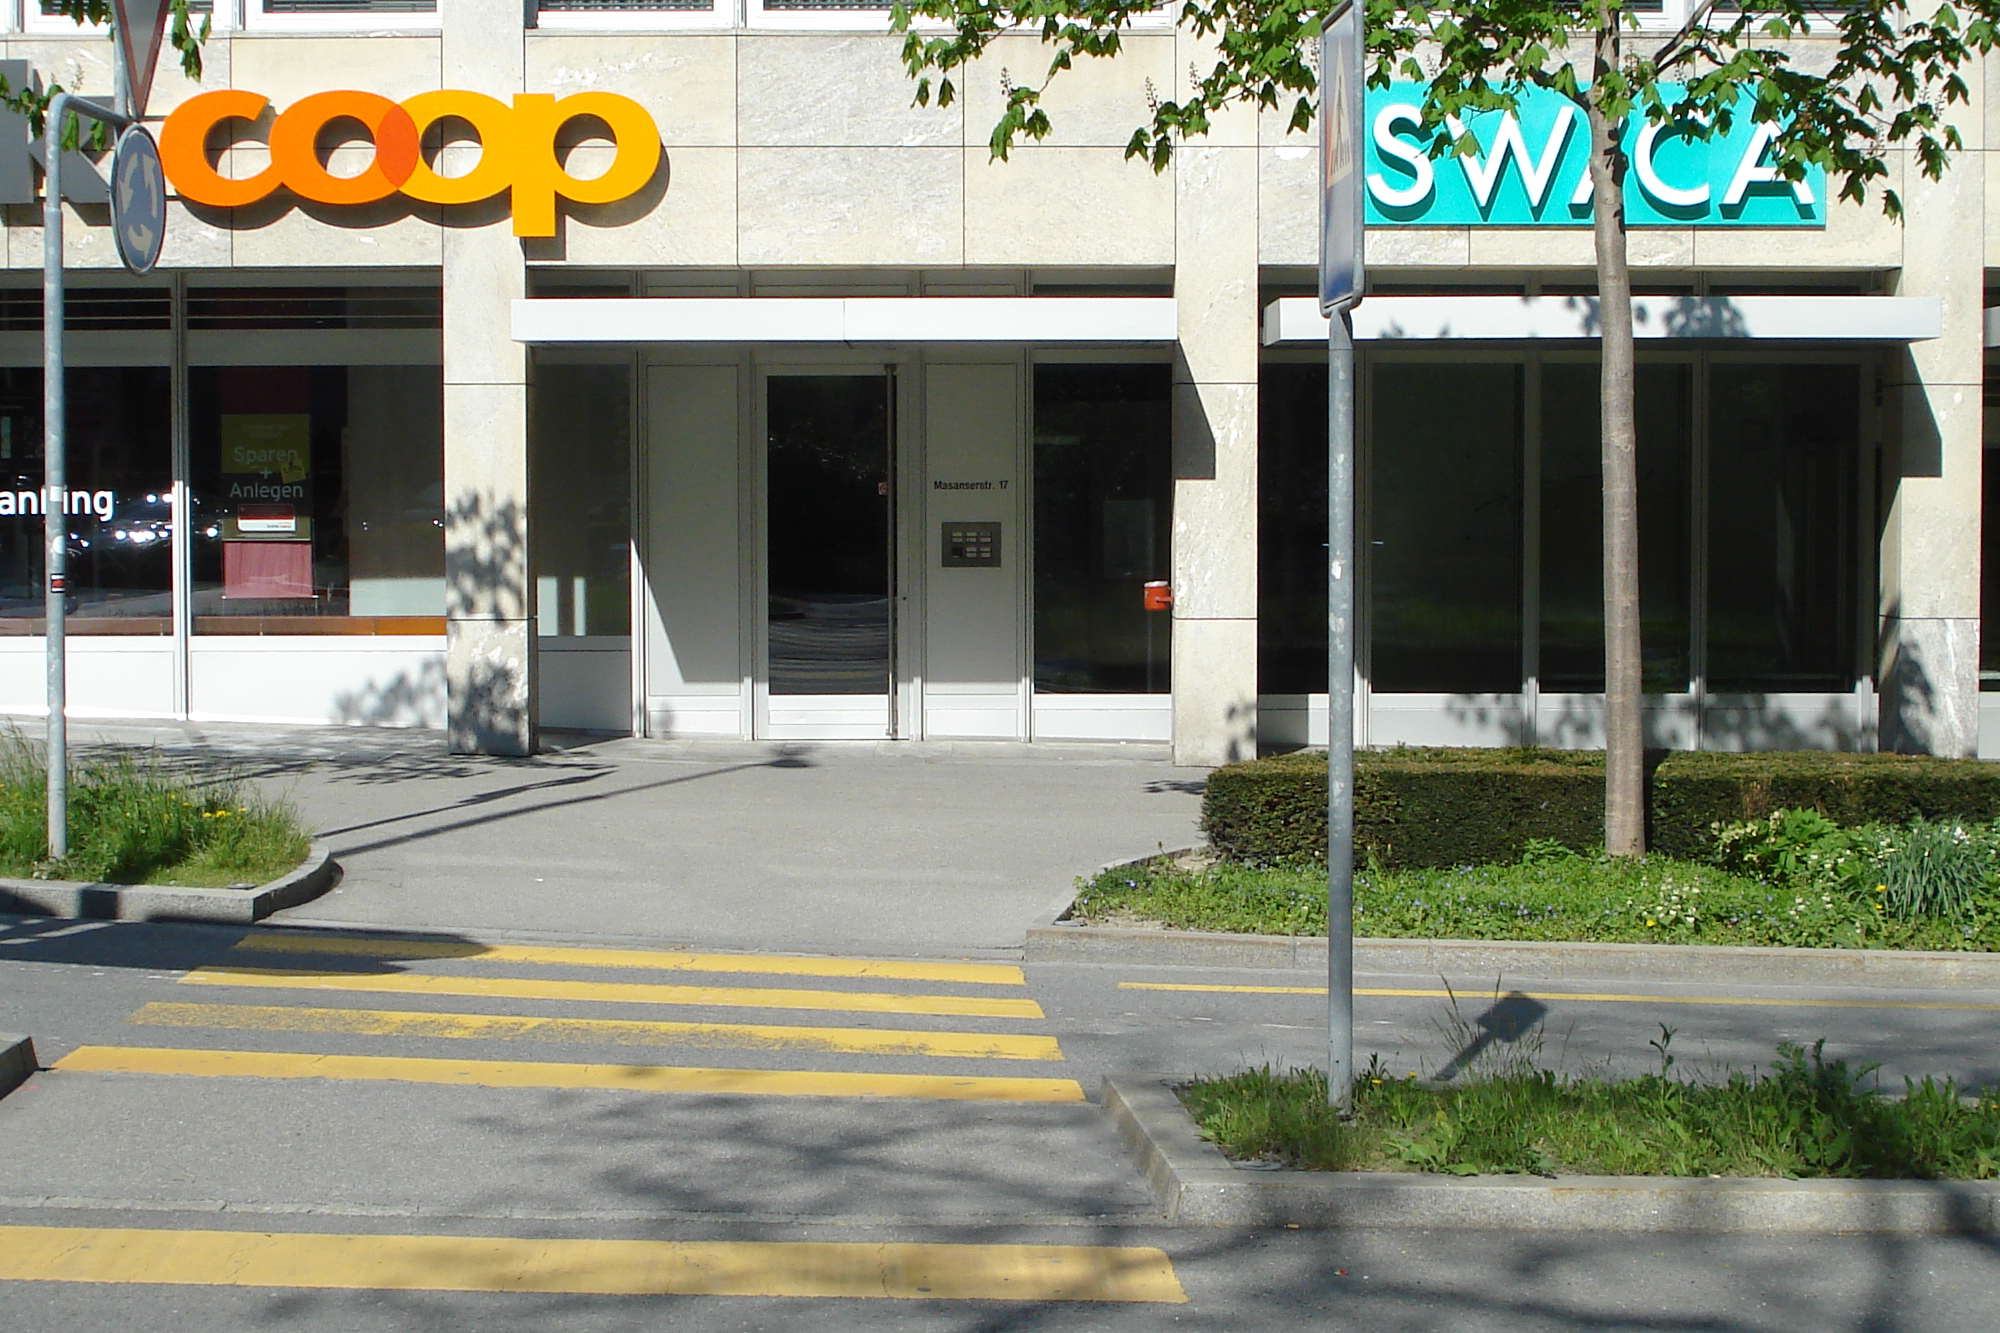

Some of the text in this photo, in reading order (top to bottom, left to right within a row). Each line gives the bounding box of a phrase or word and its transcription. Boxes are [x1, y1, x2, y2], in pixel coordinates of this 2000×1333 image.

[159, 89, 661, 237] coop
[232, 446, 299, 465] Sparen
[230, 482, 304, 502] Anlegen
[934, 480, 1009, 490] Masanserstr. 17
